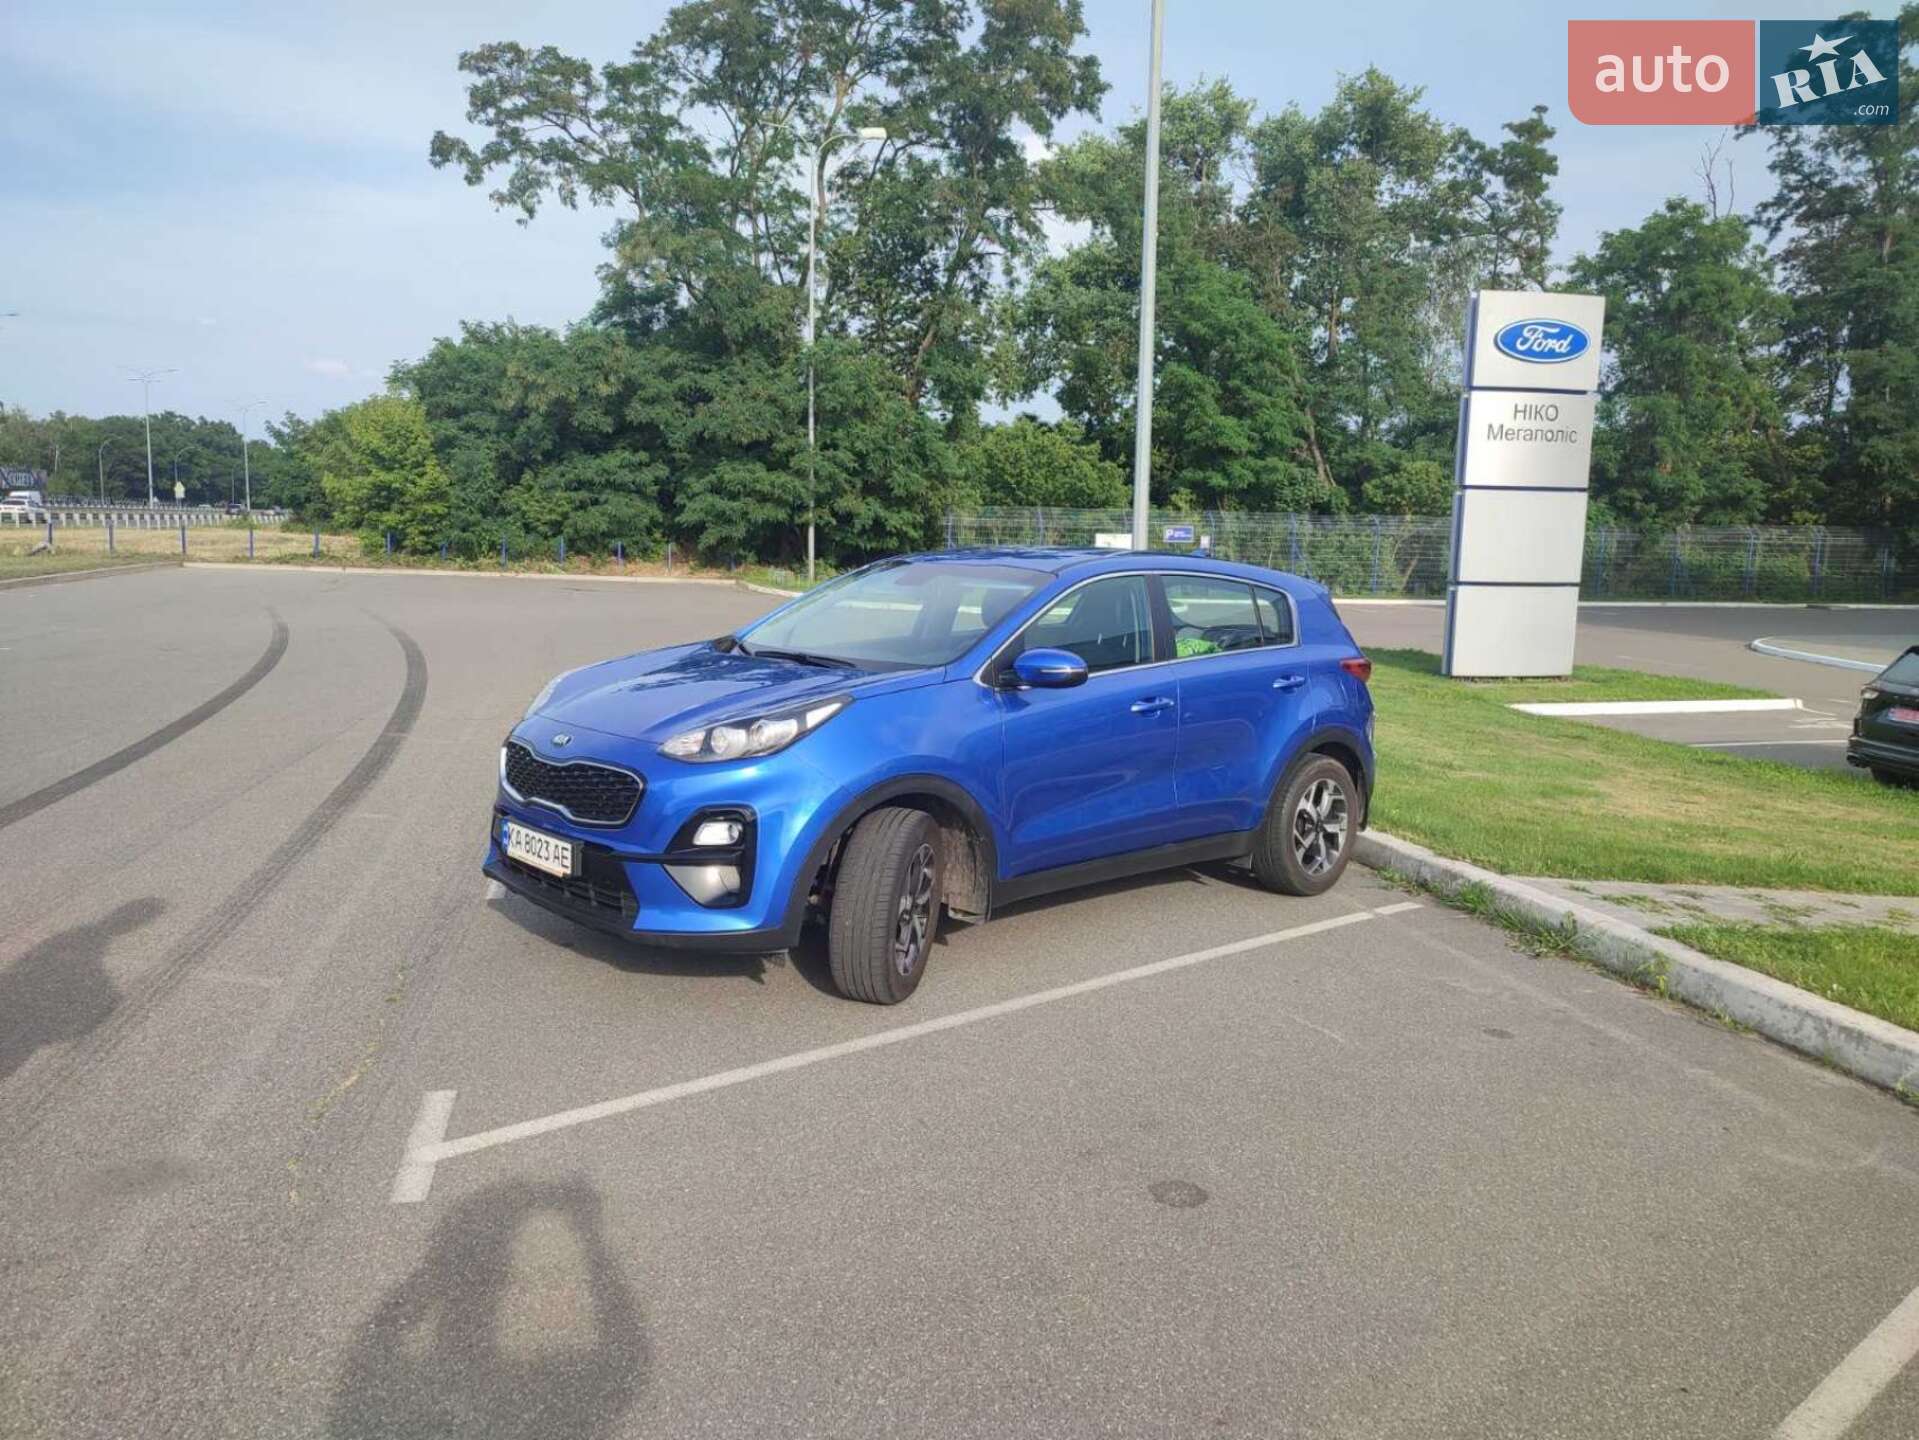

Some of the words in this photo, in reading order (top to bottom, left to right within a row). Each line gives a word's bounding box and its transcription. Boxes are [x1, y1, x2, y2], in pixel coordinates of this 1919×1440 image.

[1516, 325, 1574, 353] Ford
[1486, 423, 1578, 444] Мегаполіс
[525, 833, 550, 861] 8023
[553, 844, 570, 869] AE
